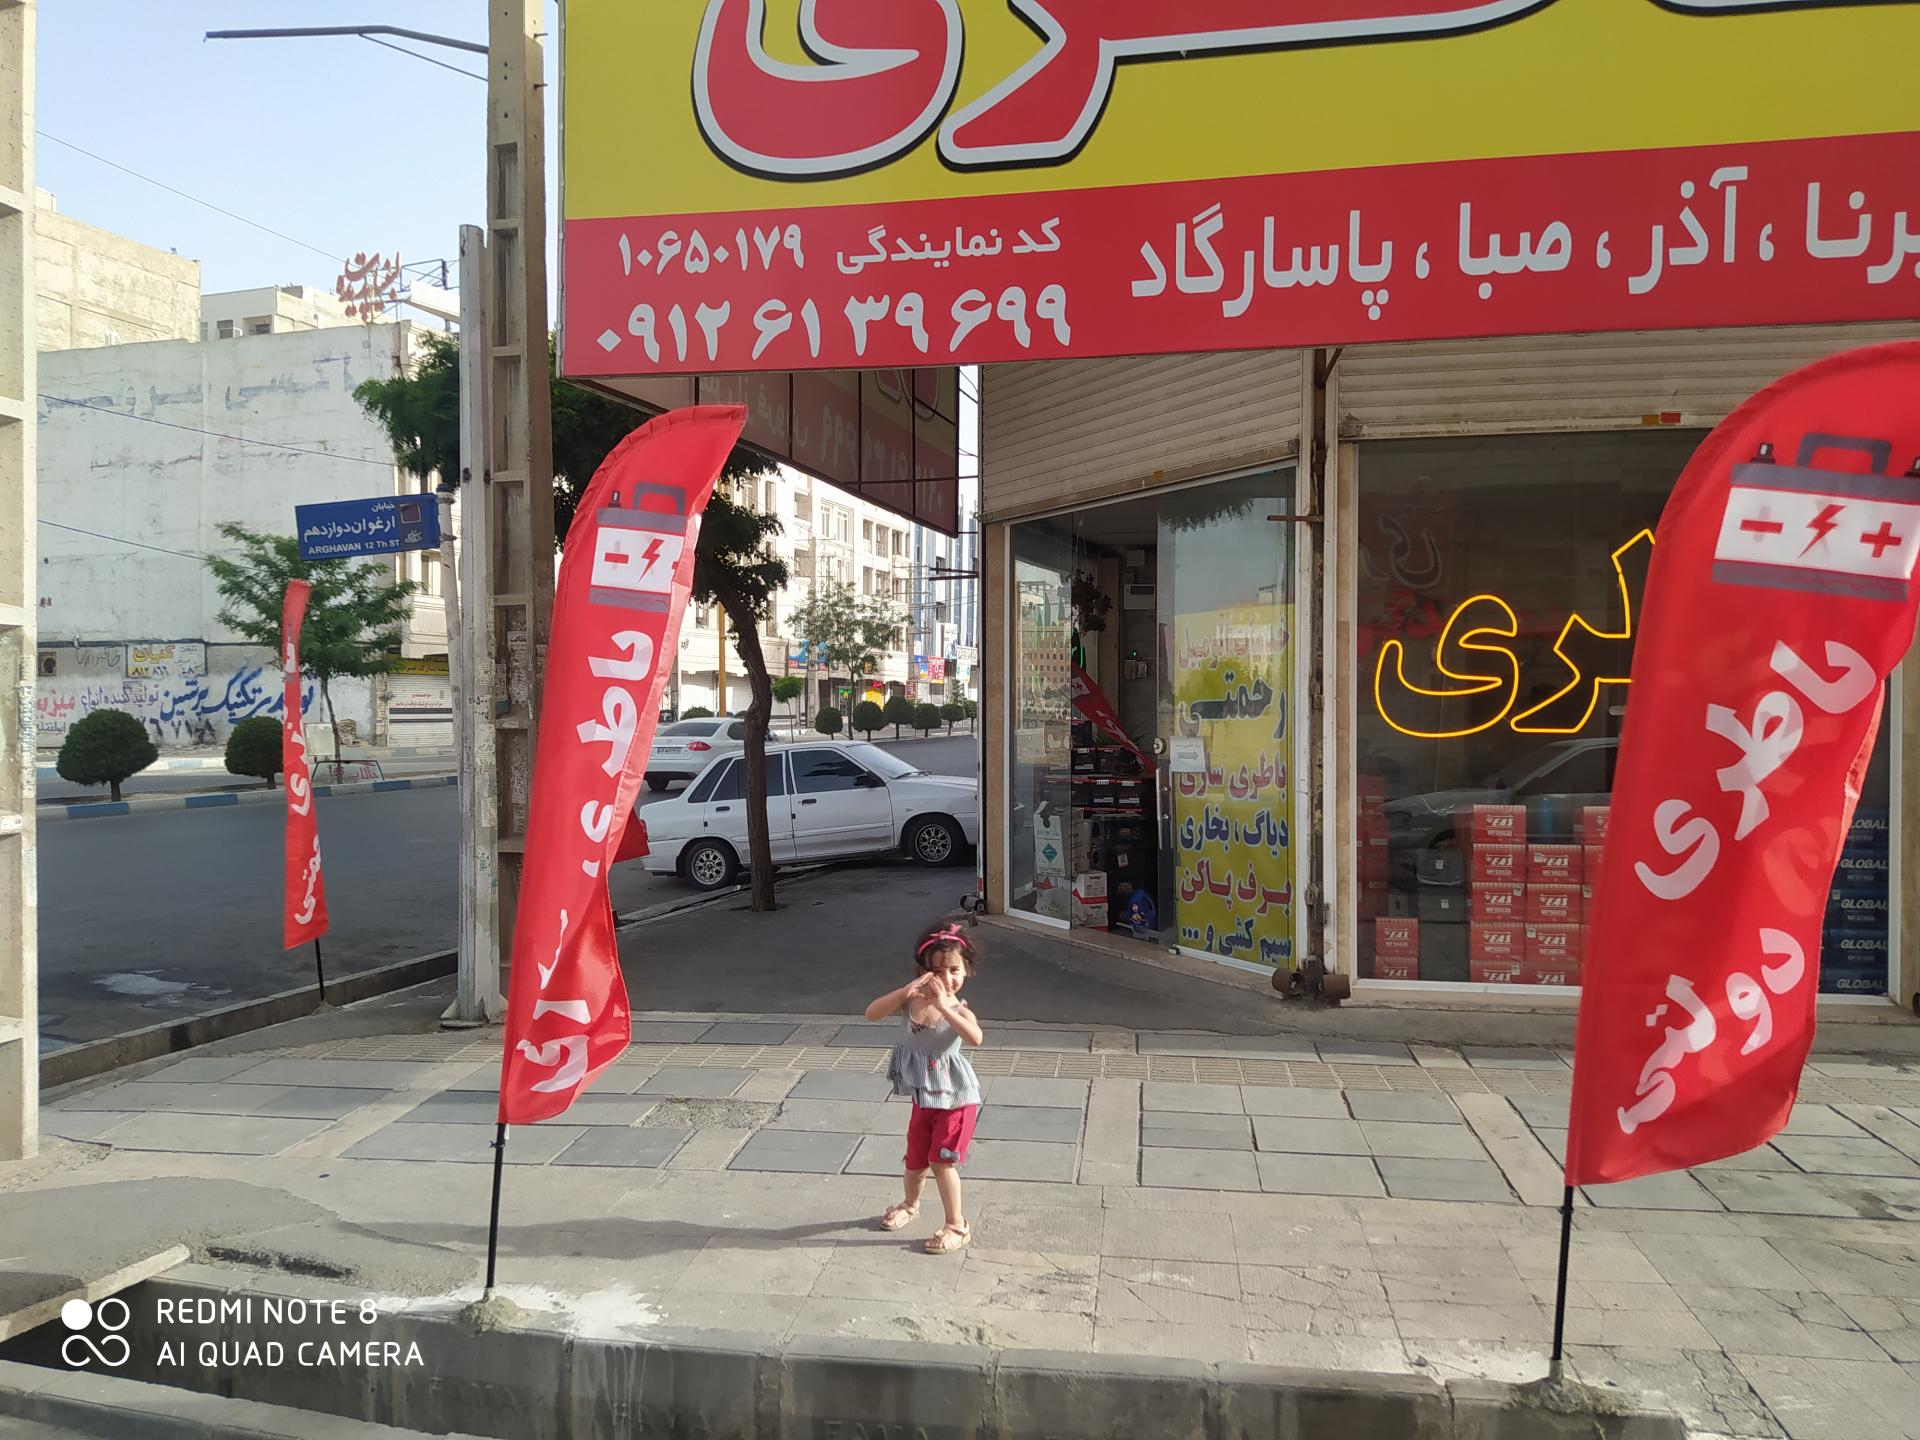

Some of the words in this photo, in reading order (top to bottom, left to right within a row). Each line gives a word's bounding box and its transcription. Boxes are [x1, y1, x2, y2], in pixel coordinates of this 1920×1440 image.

[618, 224, 805, 276] ۱۰۶۵۰۱۷۹
[836, 223, 1003, 275] نمایندگی
[1012, 217, 1061, 254] کد
[1458, 202, 1572, 300] صبا
[1628, 166, 1748, 295] آذر
[1131, 203, 1393, 321] پاسارگاد
[596, 301, 731, 363] ۰۹۱۲
[752, 298, 821, 361] ۶۱
[843, 292, 929, 357] ۳۹
[949, 284, 1071, 353] ۶۹۹
[351, 515, 396, 535] ارغوان
[371, 503, 396, 512] خیابان
[303, 521, 351, 543] دوازدهم
[308, 542, 362, 555] ARGHAVAN
[365, 541, 375, 549] 12
[389, 539, 400, 547] ST
[1179, 671, 1287, 740] رحمتی
[1229, 751, 1287, 800] باطری
[1180, 802, 1230, 851] بخاری
[1243, 810, 1289, 857] دیاگ
[1849, 819, 1888, 829] LOBAL
[1180, 858, 1233, 911] پاکن
[1840, 858, 1888, 869] GLOBAL
[1238, 862, 1292, 916] برف
[1840, 899, 1888, 910] GLOBAL
[1218, 916, 1254, 955] کشی
[1260, 935, 1292, 963] سیم
[1840, 939, 1888, 950] GLOBAL
[1836, 978, 1886, 989] GLOBAL
